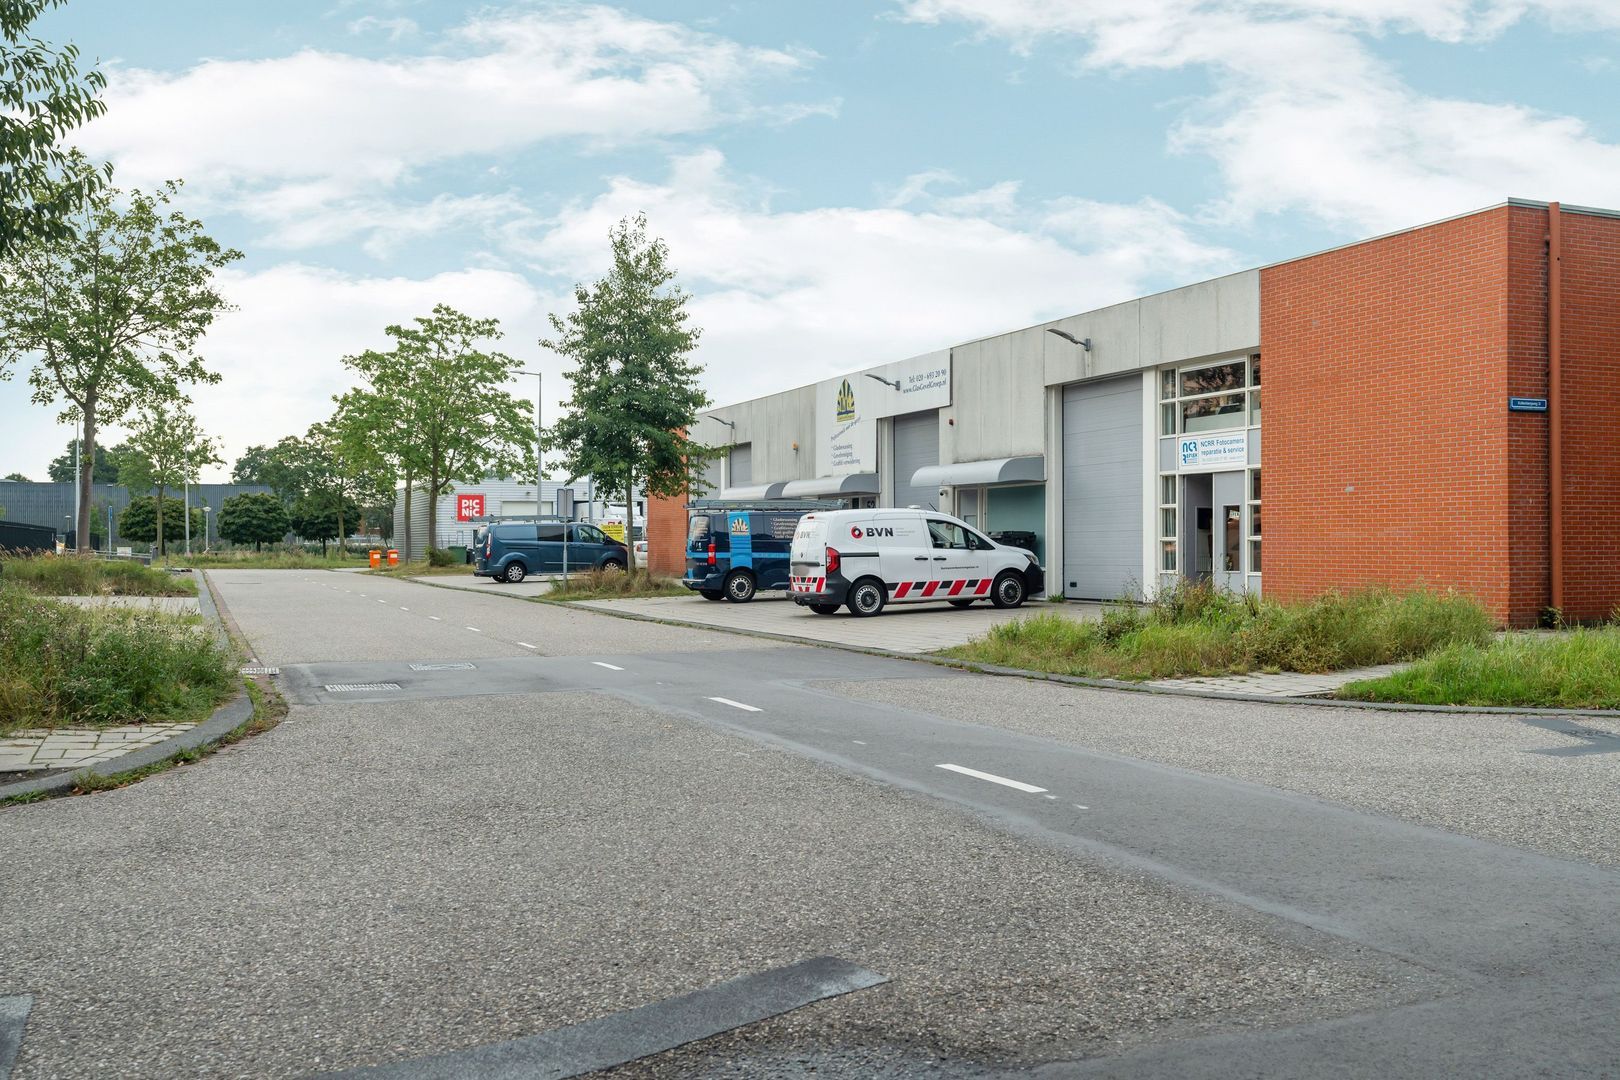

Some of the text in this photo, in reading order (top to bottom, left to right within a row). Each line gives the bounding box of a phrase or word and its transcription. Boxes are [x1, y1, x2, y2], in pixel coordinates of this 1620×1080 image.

[1200, 438, 1244, 448] NCRR Fotocamera
[461, 499, 480, 508] PIC
[865, 527, 894, 537] BVN
